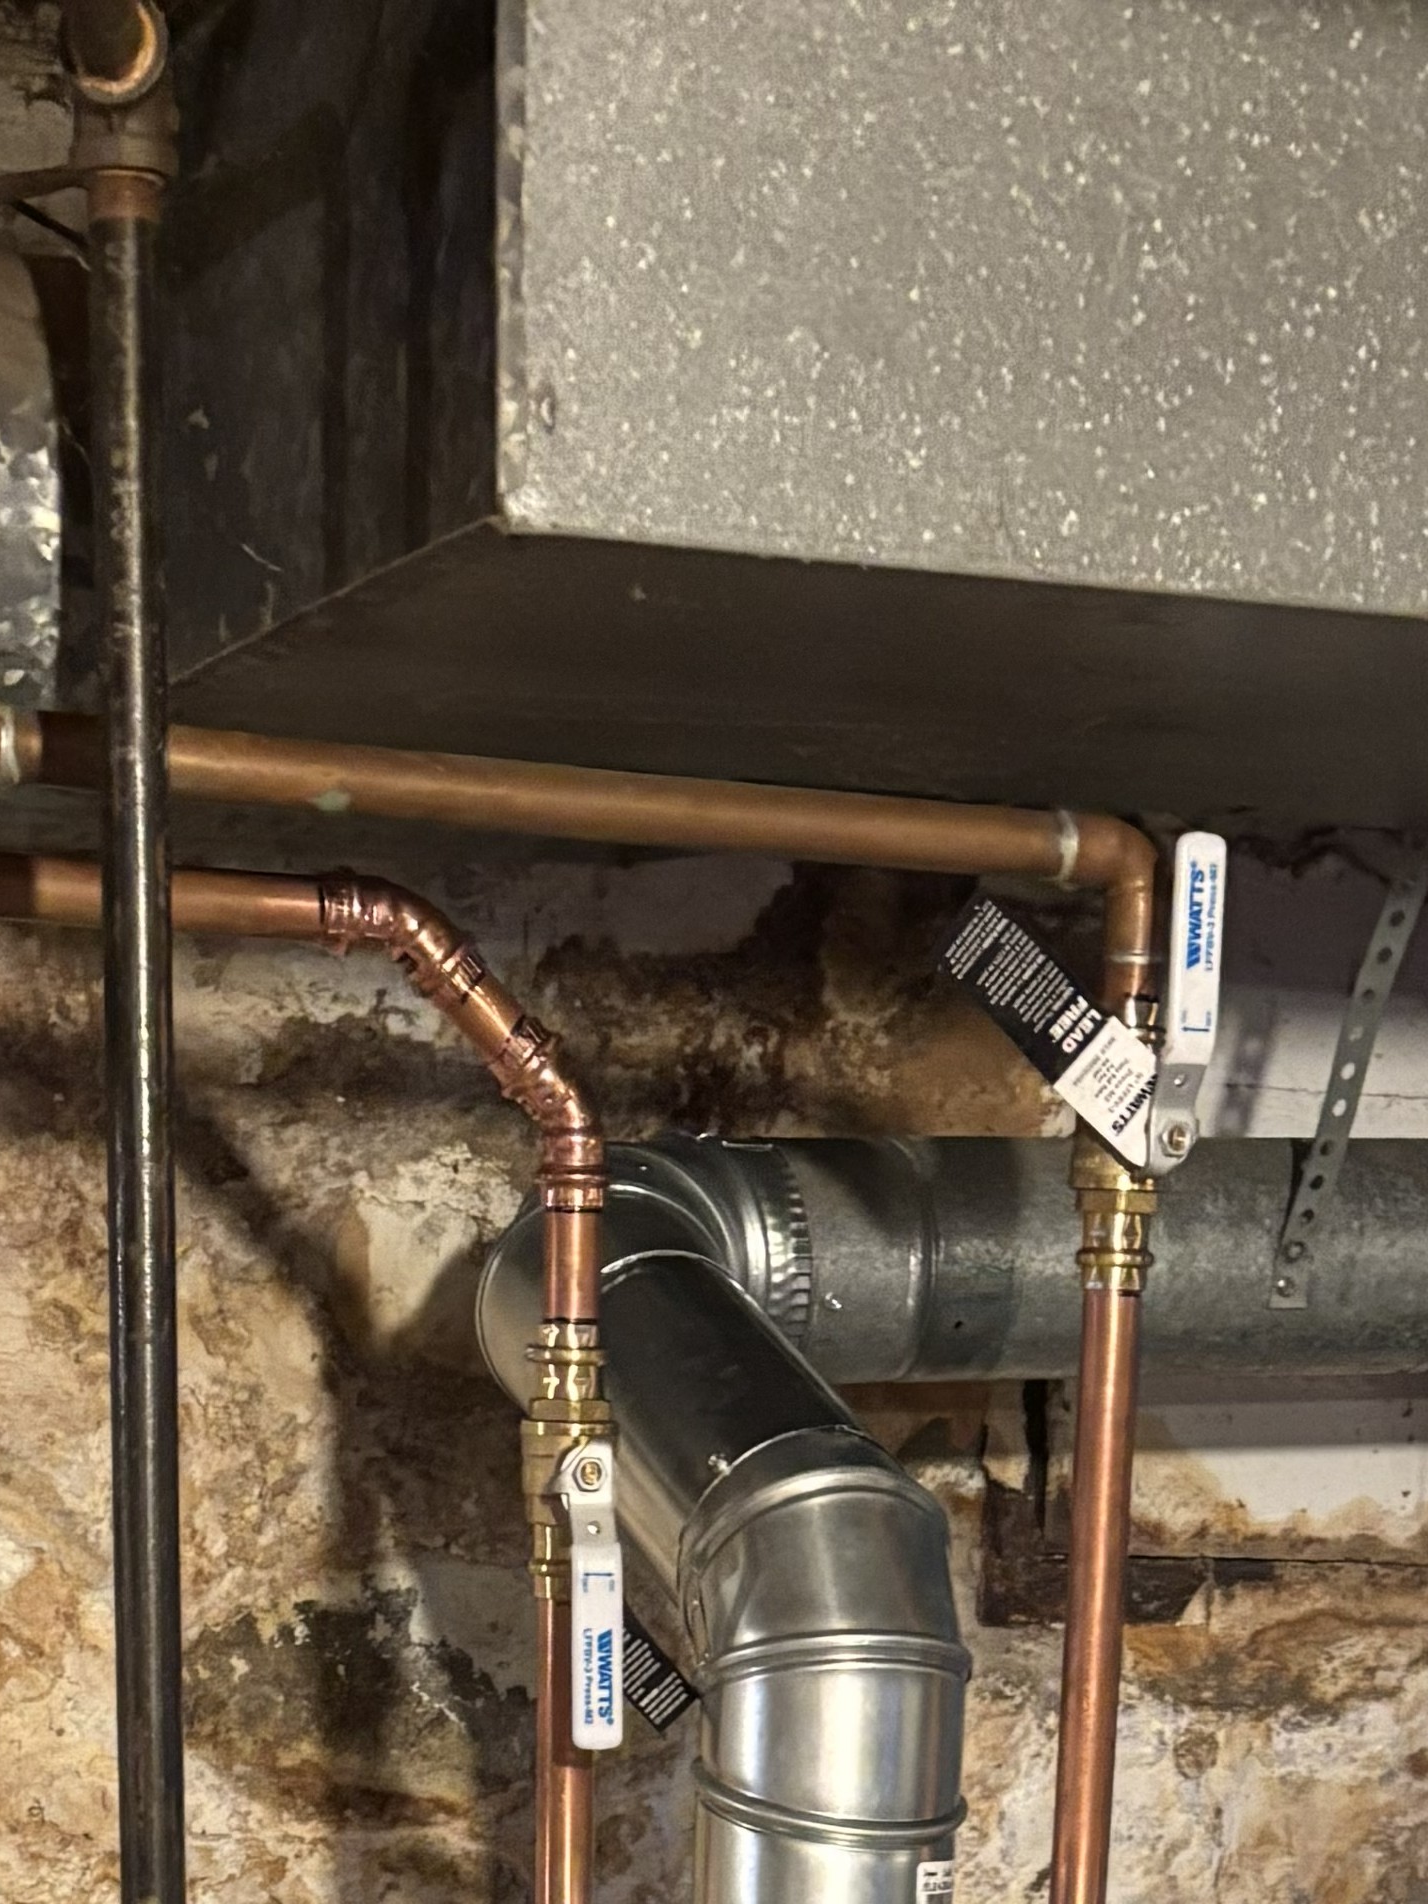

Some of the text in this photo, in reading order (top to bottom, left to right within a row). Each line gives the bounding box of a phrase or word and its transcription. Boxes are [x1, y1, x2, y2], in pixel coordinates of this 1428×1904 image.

[1188, 869, 1205, 942] WATTS
[1048, 995, 1089, 1043] FREE
[1062, 1008, 1102, 1053] LEAD
[597, 1653, 613, 1719] WATTS
